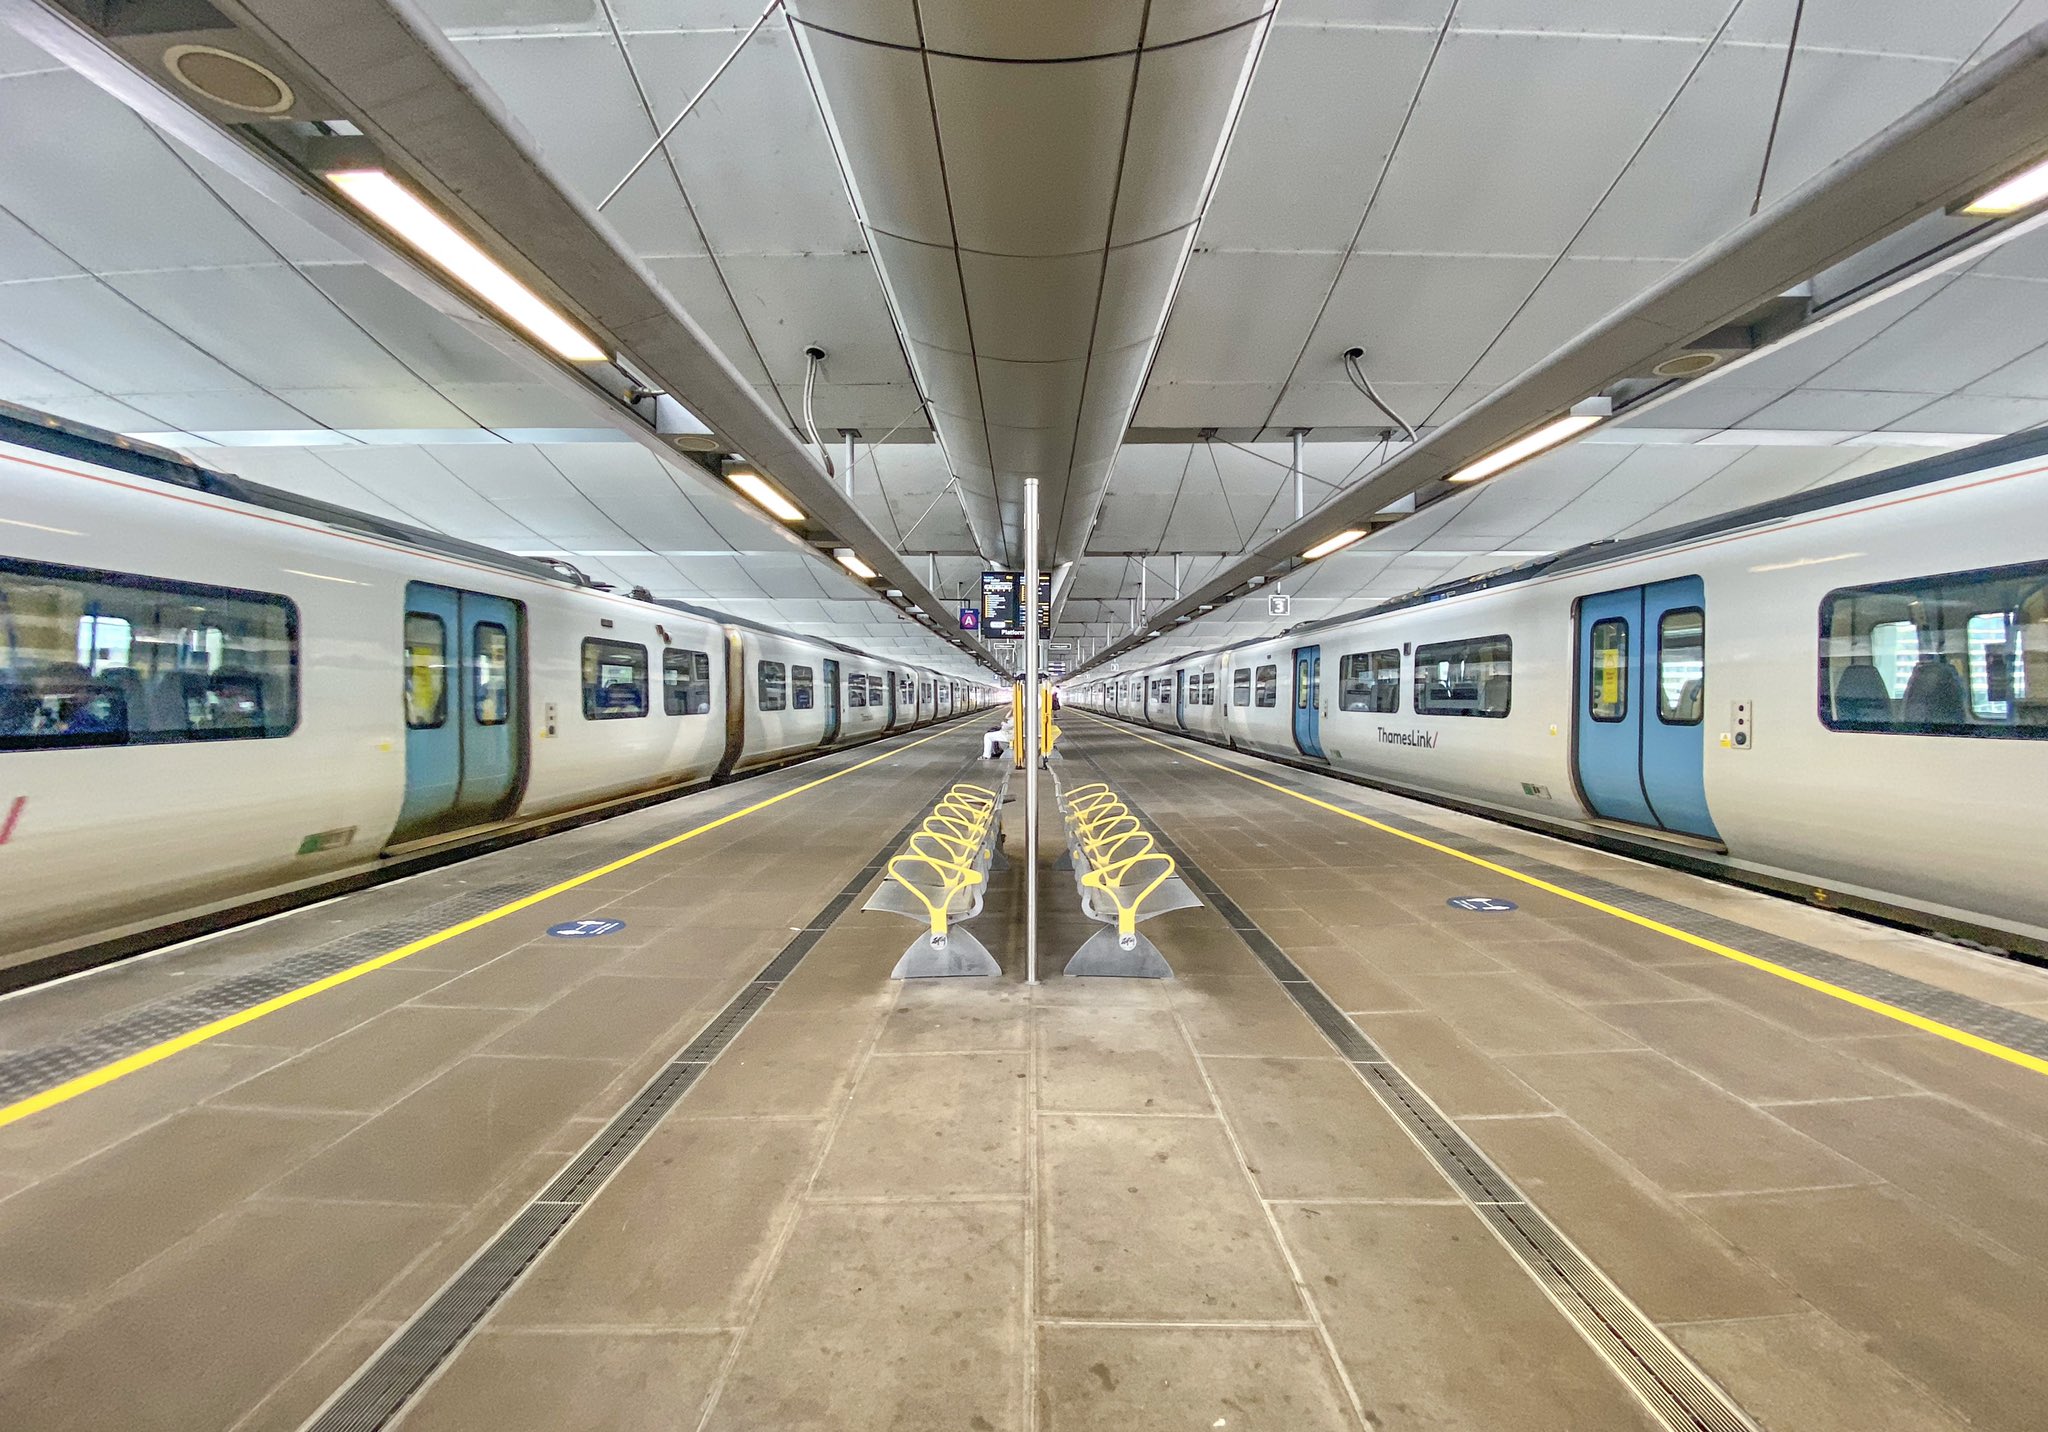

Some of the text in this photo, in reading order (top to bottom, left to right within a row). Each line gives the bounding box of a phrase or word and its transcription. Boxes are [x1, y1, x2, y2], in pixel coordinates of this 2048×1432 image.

[1274, 600, 1284, 613] 3
[964, 615, 974, 626] A
[1377, 726, 1433, 749] ThamesLink
